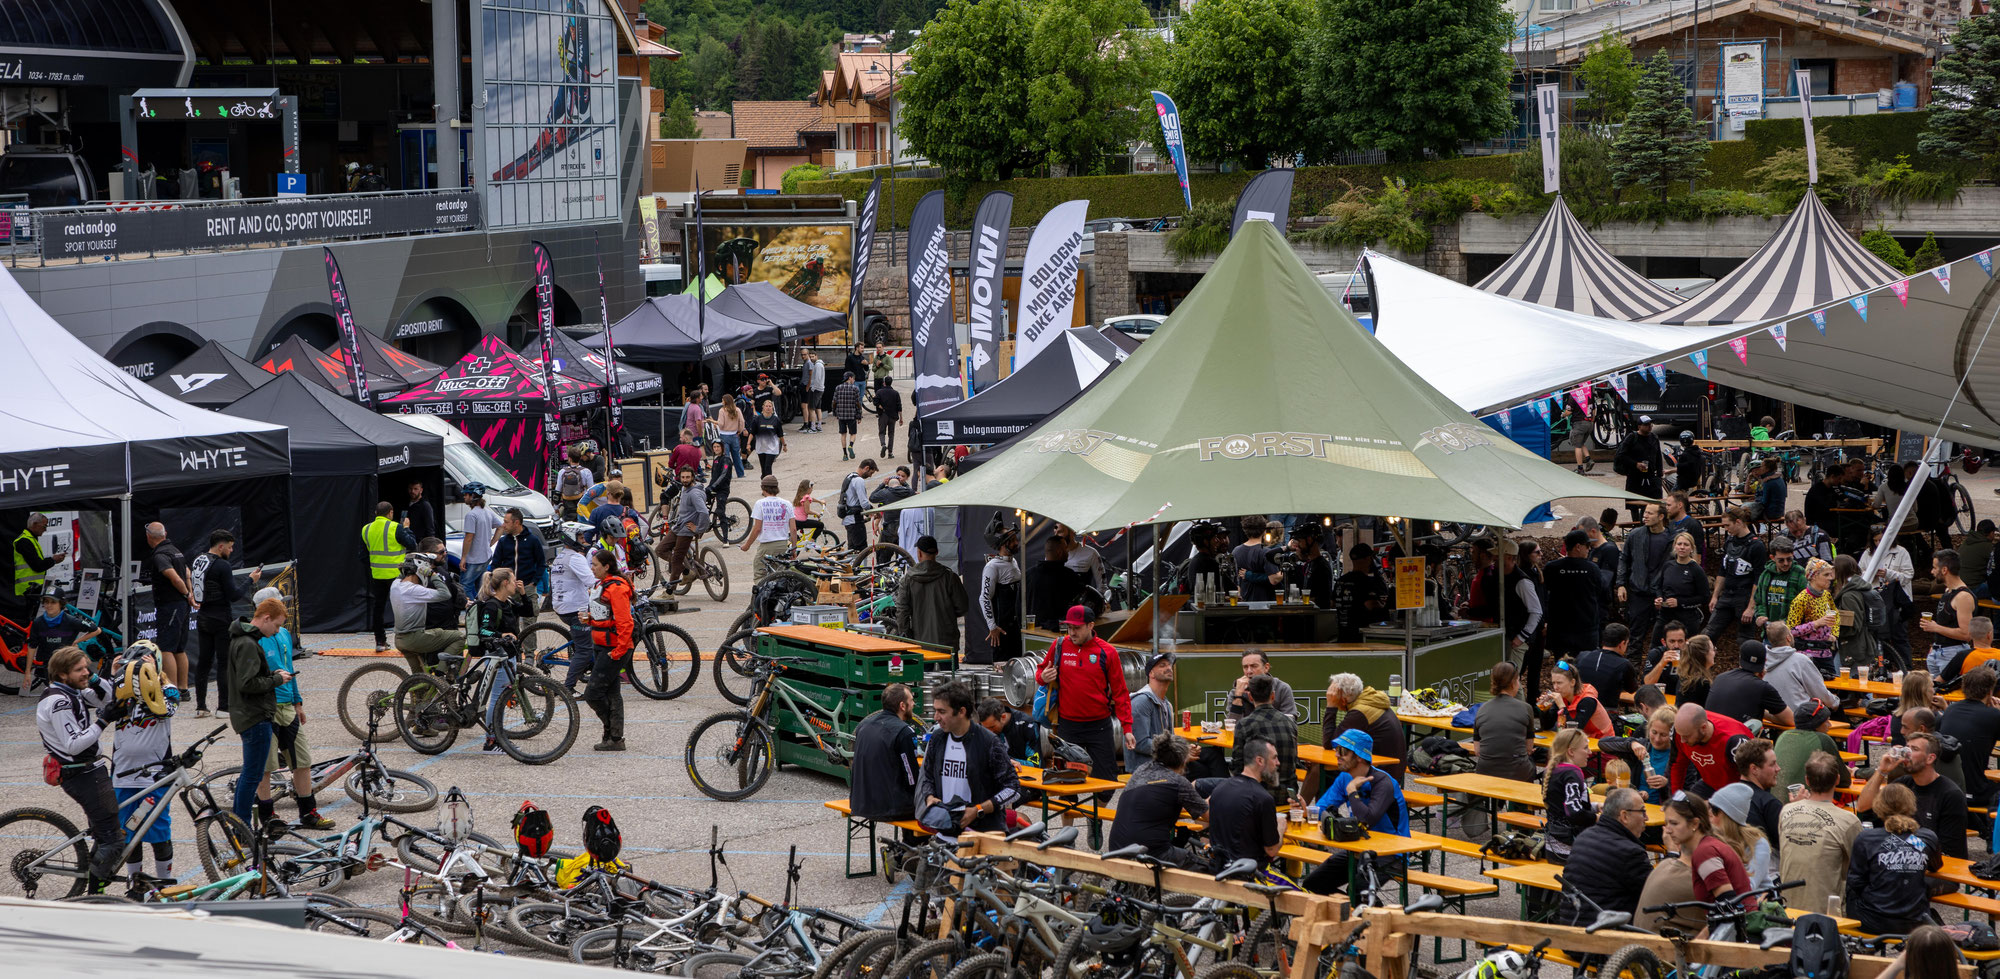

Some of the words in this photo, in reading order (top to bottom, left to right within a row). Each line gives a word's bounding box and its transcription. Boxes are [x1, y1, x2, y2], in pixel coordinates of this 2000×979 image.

[288, 177, 297, 190] P
[436, 201, 449, 212] rent
[449, 200, 460, 211] and
[460, 201, 468, 212] go
[206, 217, 236, 237] RENT
[238, 215, 262, 235] AND
[264, 213, 284, 235] GO,
[285, 211, 318, 231] SPORT
[320, 208, 372, 228] YOURSELF!
[436, 214, 449, 225] SPORT
[449, 213, 468, 224] YOURSELF
[64, 221, 85, 236] rent
[86, 219, 103, 235] and
[104, 222, 117, 237] go
[65, 241, 85, 253] SPORT
[87, 239, 117, 251] YOURSELF
[1028, 231, 1084, 290] BOLOGNA
[970, 223, 1000, 342] MOWI
[1026, 255, 1081, 317] MONTANA
[427, 318, 443, 333] RENT
[915, 302, 940, 348] BIKE
[1023, 308, 1055, 343] BIKE
[440, 377, 506, 391] Muc-Off
[416, 403, 452, 414] Muc-Off
[474, 402, 510, 413] Muc-Off
[1199, 432, 1333, 462] FORST
[180, 446, 248, 472] WHYTE
[378, 455, 405, 466] ENDURA
[0, 463, 71, 493] HYTE
[1402, 564, 1418, 573] BAR
